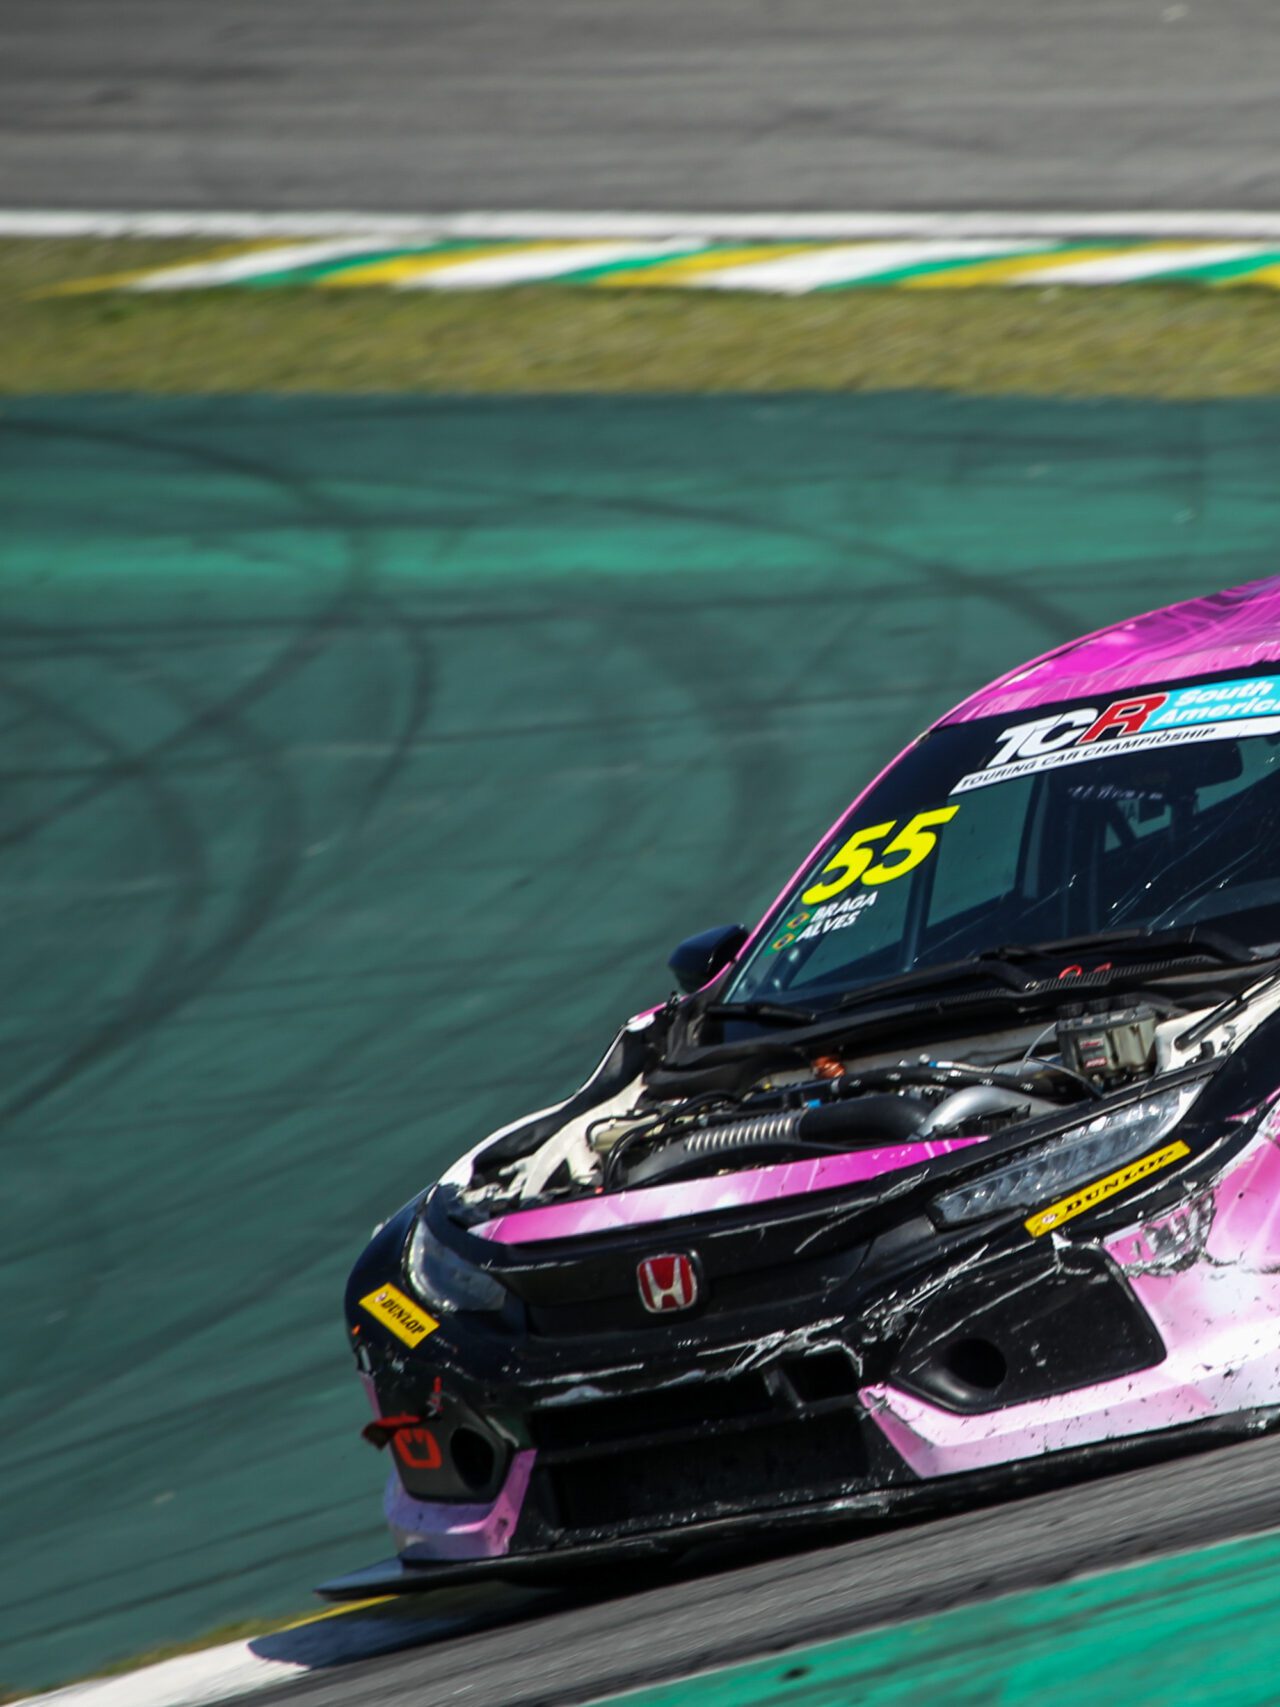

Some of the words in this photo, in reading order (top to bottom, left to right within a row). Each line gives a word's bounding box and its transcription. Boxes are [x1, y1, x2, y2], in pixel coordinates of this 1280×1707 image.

[1174, 680, 1274, 706] South
[986, 692, 1169, 770] TCR
[961, 762, 1035, 787] TOURING
[1042, 751, 1078, 766] CAR
[802, 805, 960, 904] 55
[810, 891, 878, 923] BRAGA
[796, 910, 861, 943] ALVES
[1065, 1150, 1175, 1213] DUNLOP
[381, 1299, 426, 1334] DUNLOP
